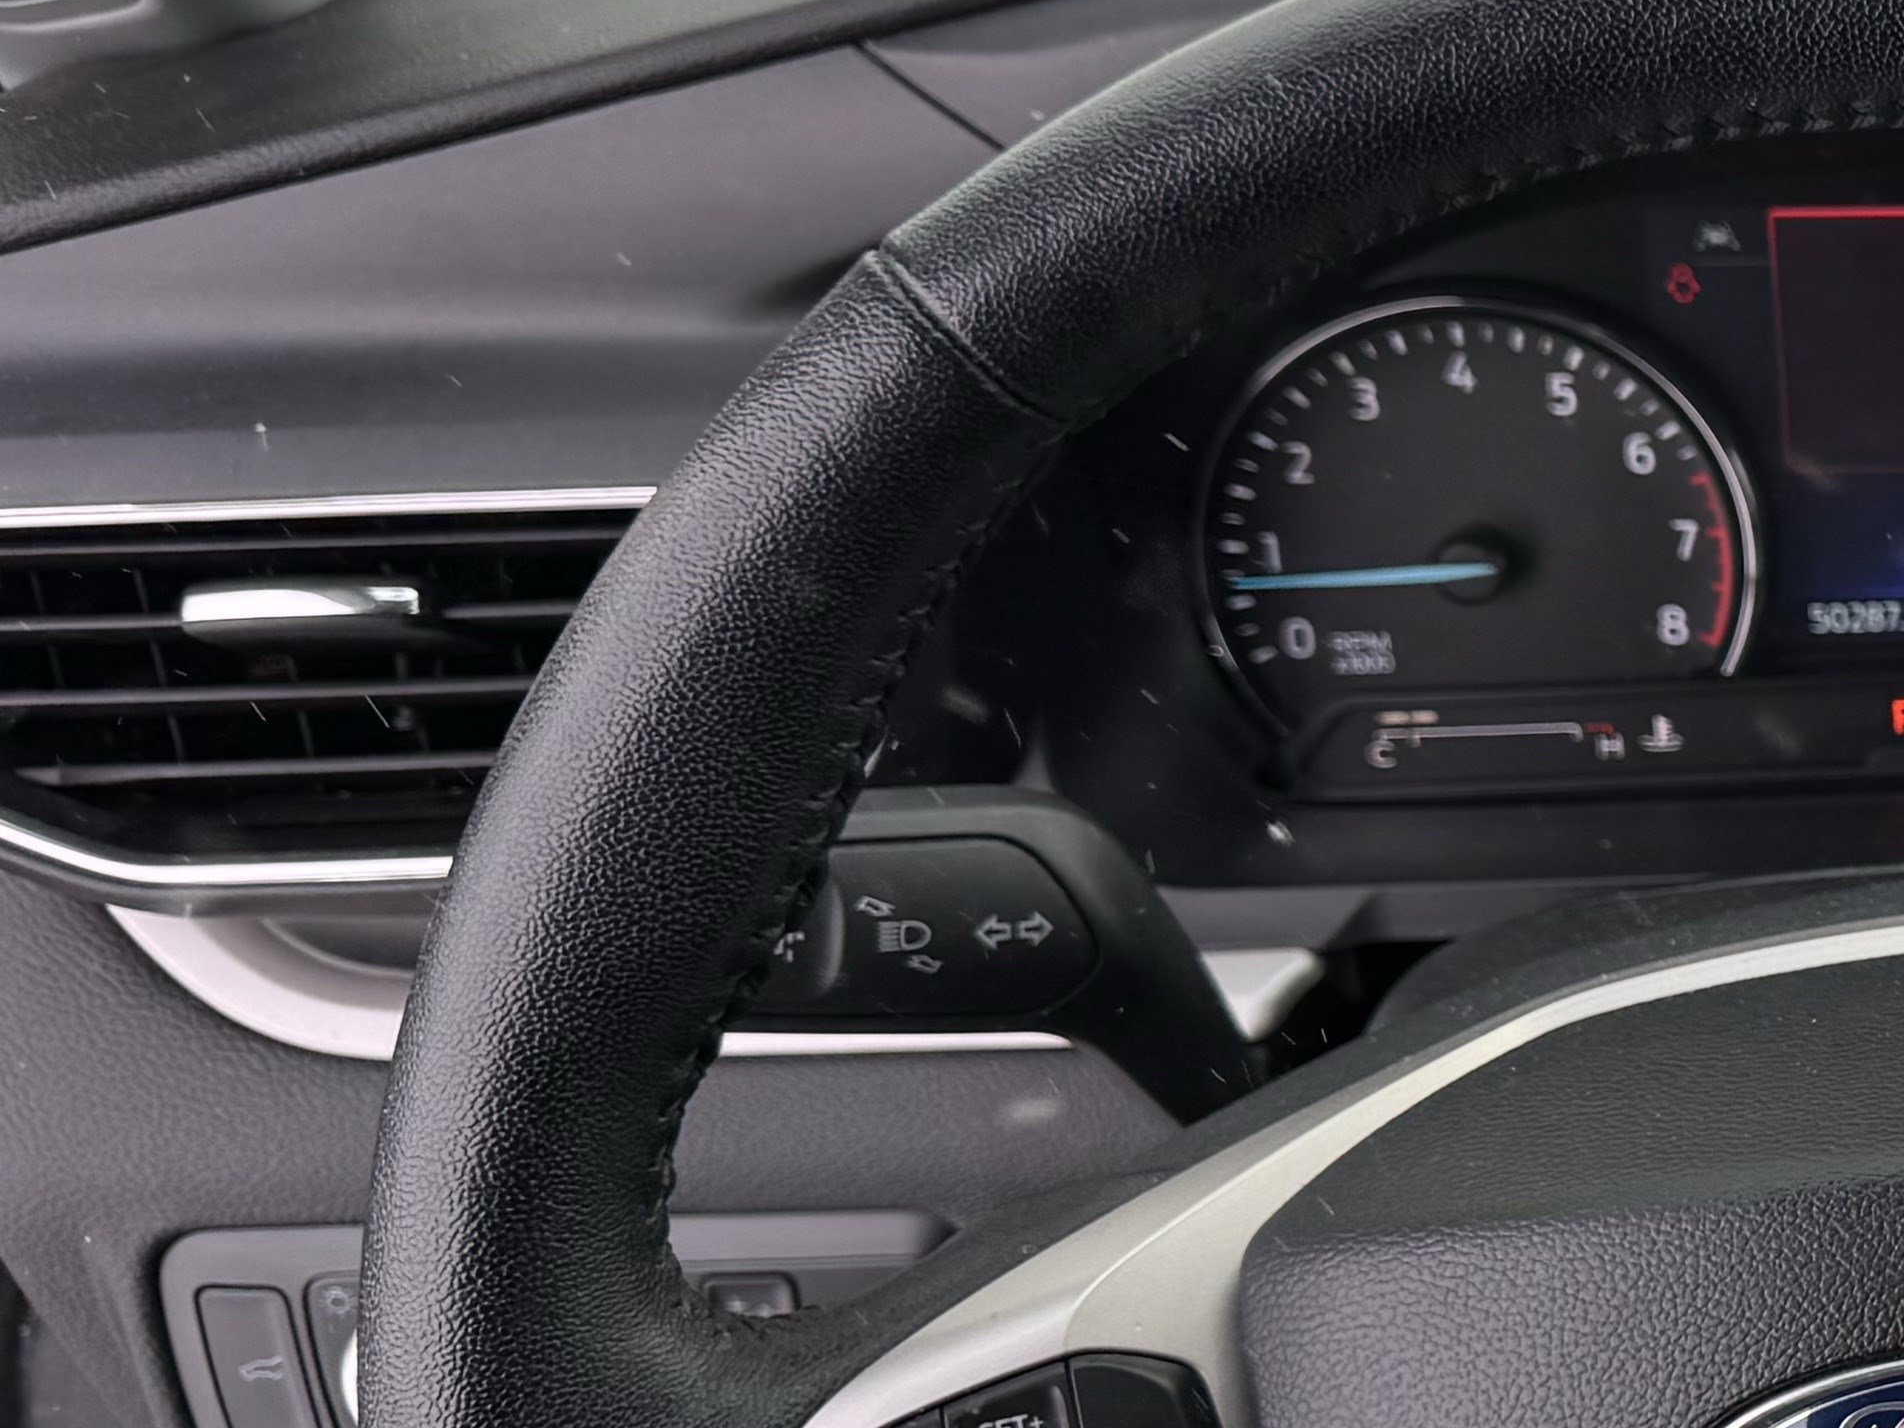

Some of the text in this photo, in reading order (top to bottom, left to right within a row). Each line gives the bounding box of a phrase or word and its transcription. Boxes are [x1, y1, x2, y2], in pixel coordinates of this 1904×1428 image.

[1443, 355, 1478, 393] 4
[1546, 373, 1577, 416] 5
[1350, 378, 1380, 421] 3
[1283, 442, 1315, 486] 2
[1623, 433, 1656, 474] 6
[1669, 518, 1700, 561] 7
[1278, 617, 1316, 660] 0
[1655, 603, 1690, 646] 8
